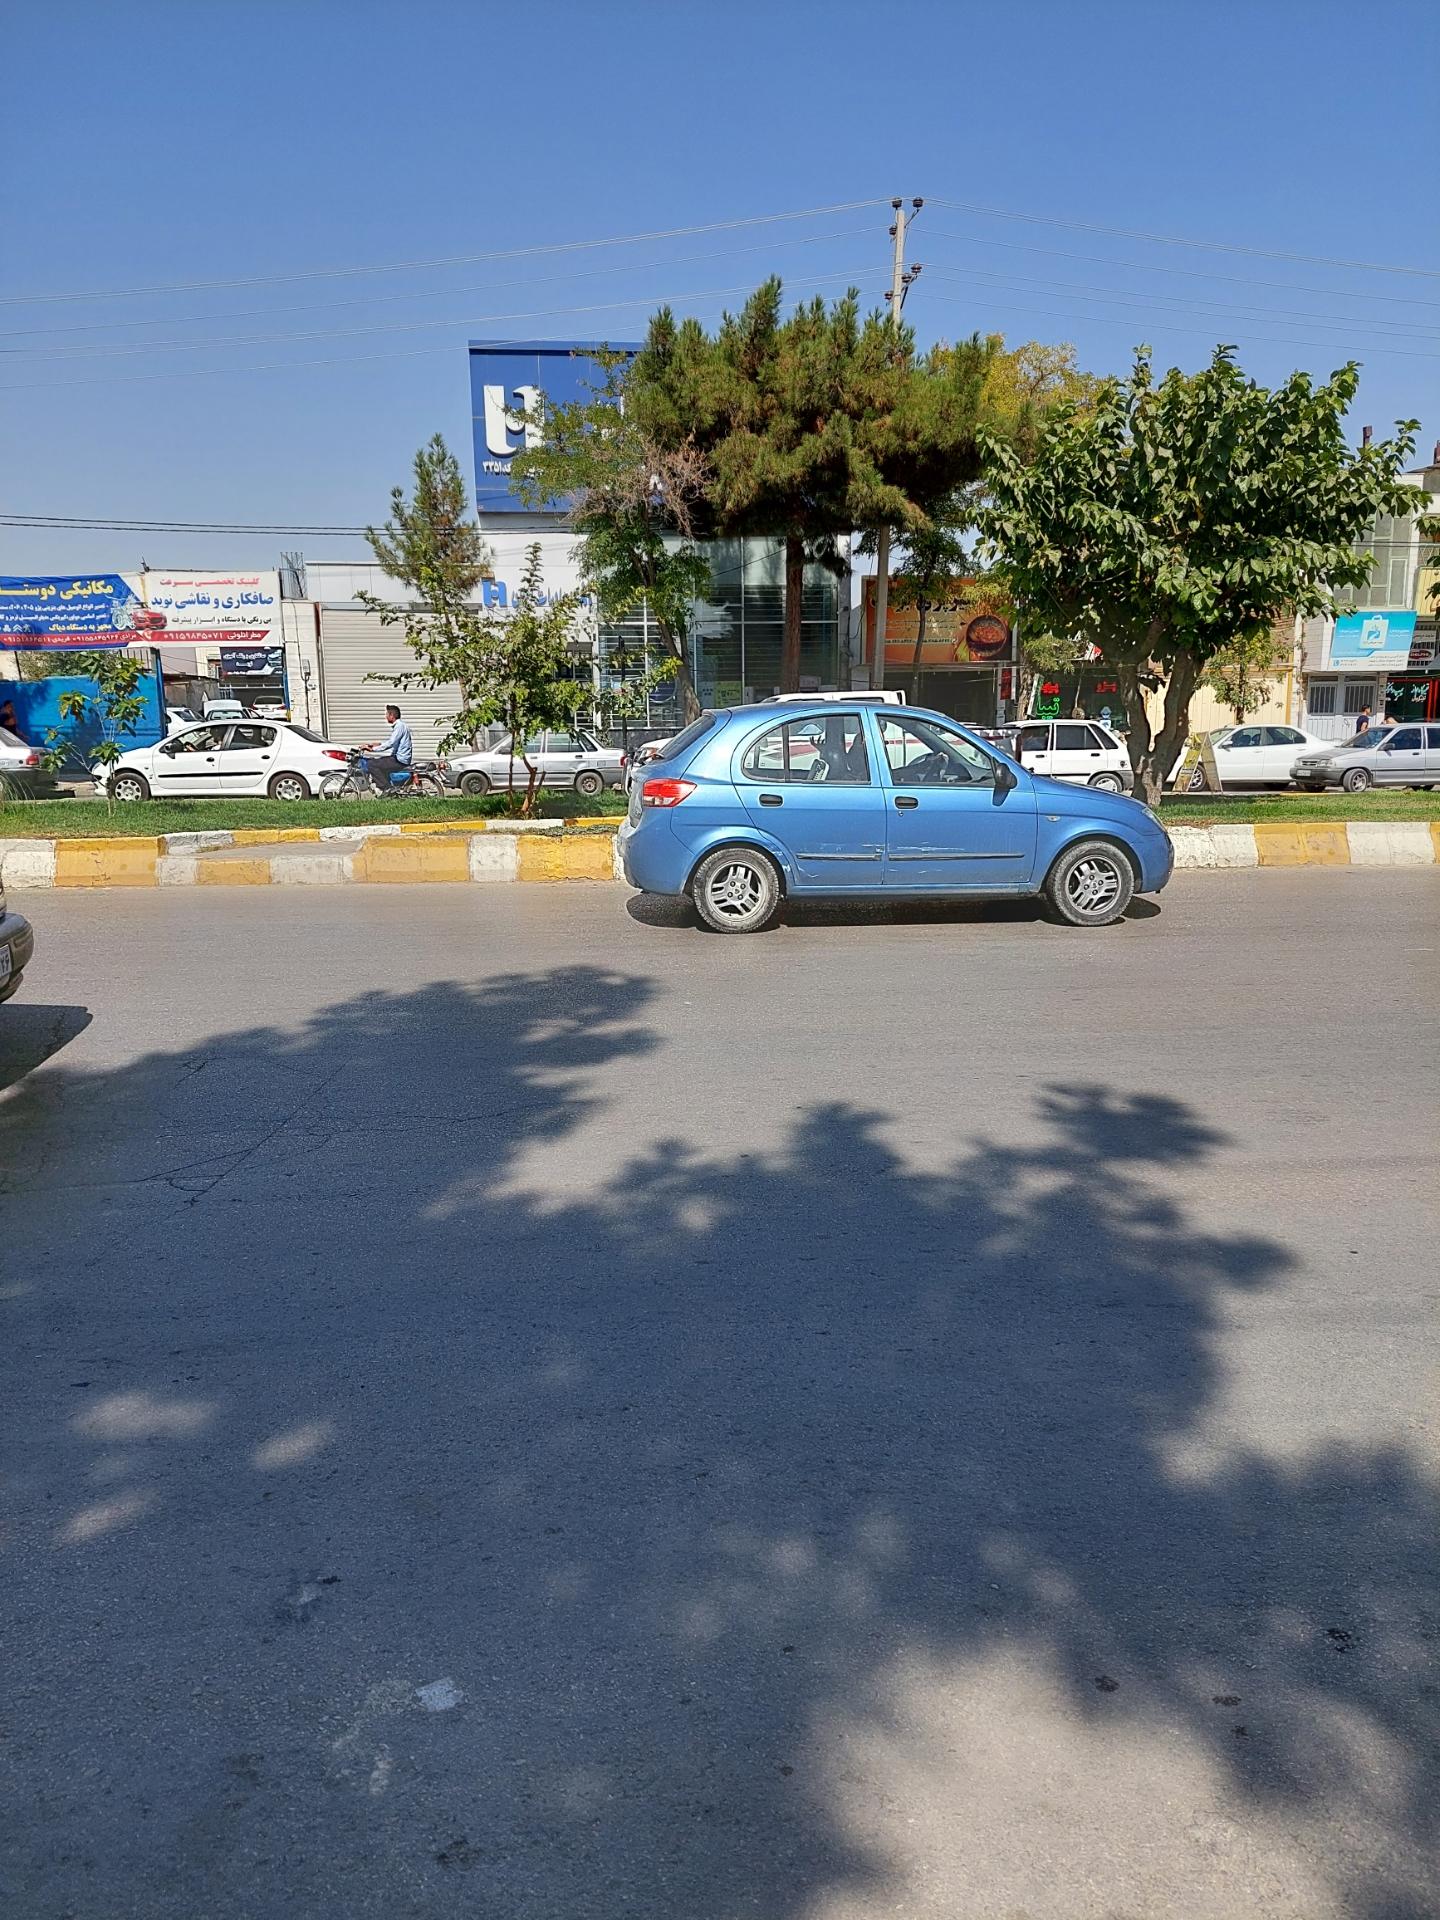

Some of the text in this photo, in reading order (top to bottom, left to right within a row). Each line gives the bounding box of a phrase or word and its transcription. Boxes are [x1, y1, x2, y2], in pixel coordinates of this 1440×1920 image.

[60, 580, 114, 600] مکانیکی
[151, 592, 274, 611] صافکاری و نقاشی نوید
